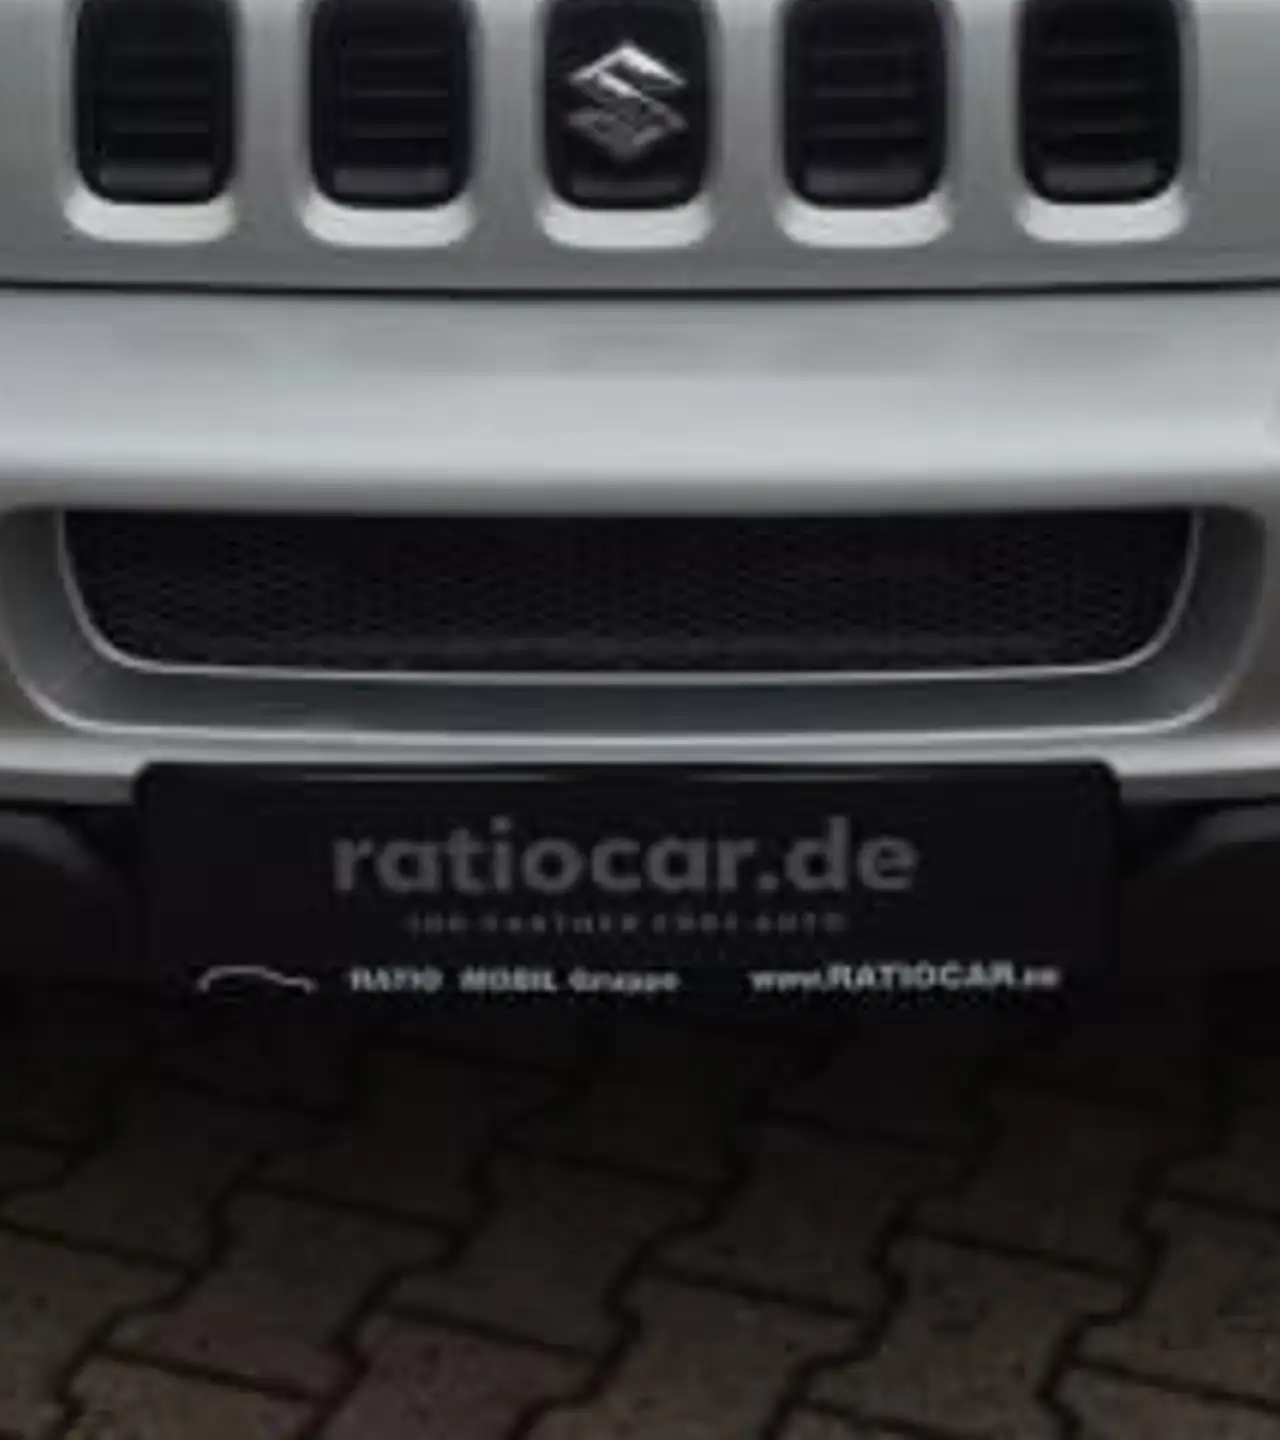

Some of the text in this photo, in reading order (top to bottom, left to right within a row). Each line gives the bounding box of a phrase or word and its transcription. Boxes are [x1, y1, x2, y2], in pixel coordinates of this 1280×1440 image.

[333, 815, 918, 894] ratiocar.de
[347, 967, 444, 992] RATIO
[459, 967, 559, 992] MOBIL
